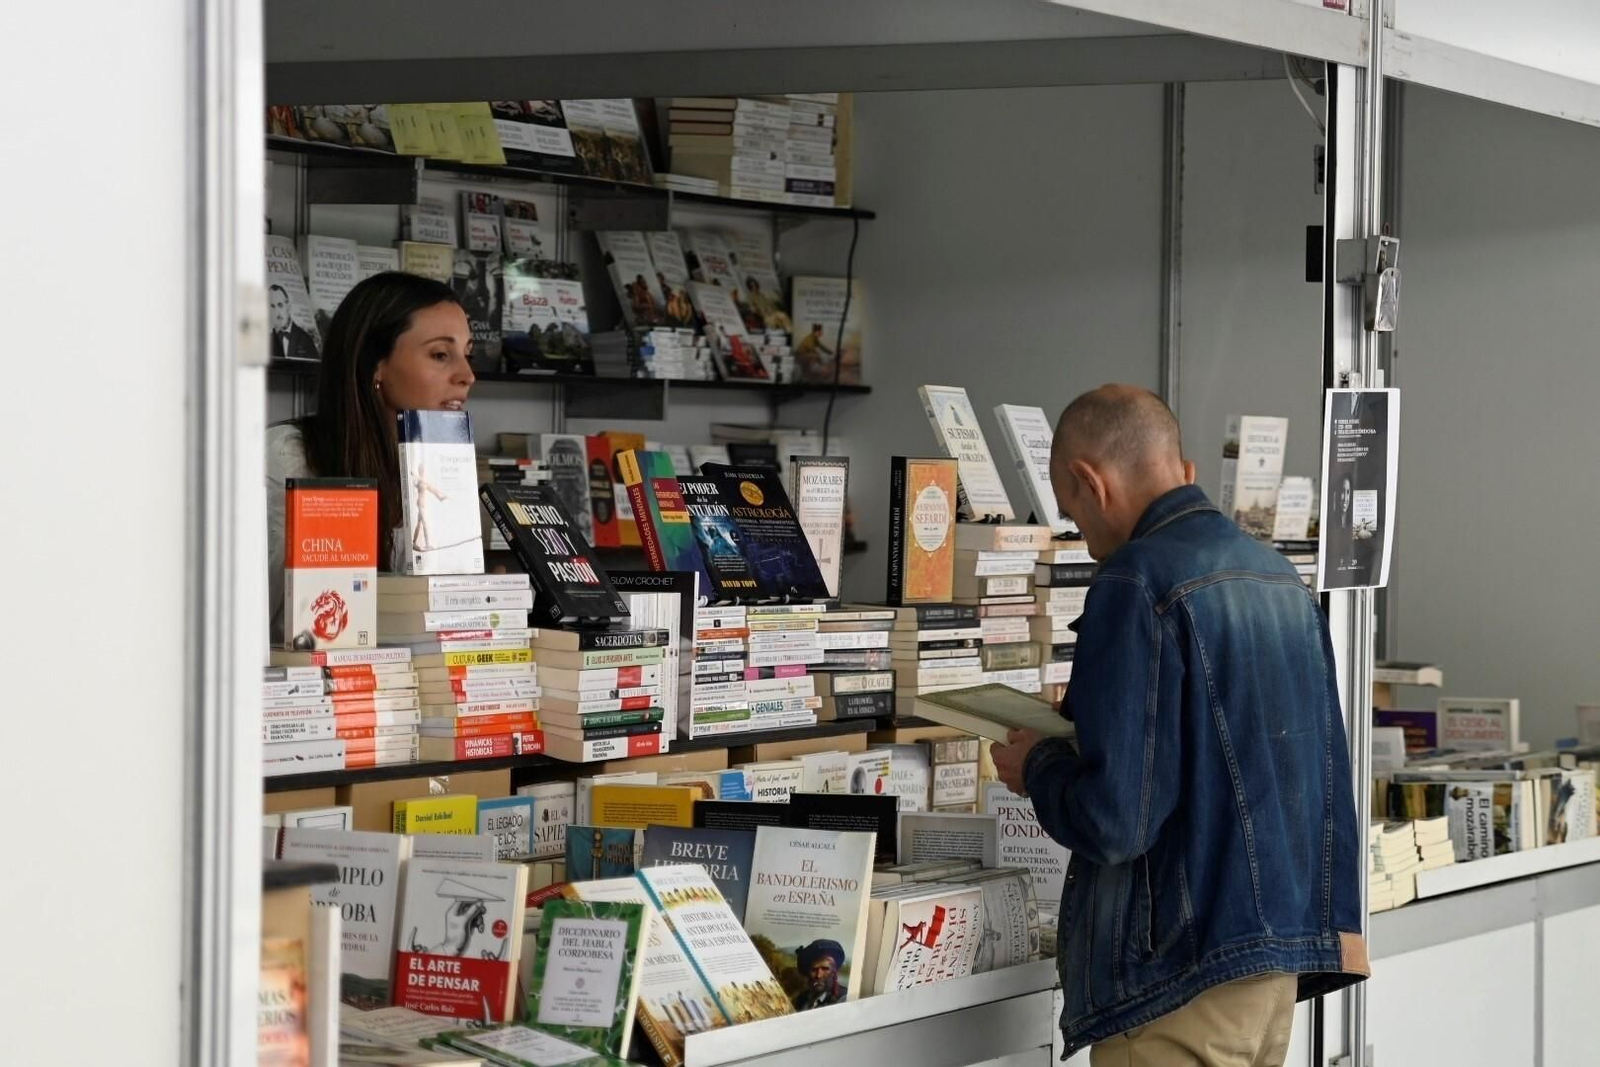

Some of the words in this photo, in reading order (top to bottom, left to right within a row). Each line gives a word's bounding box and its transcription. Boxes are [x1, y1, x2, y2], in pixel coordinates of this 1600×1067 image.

[522, 294, 548, 306] Baza
[802, 472, 844, 486] MOZÁRABES
[688, 482, 720, 496] PODER
[632, 487, 646, 522] MENTALES
[732, 506, 792, 518] ASTROLOGÍA
[302, 538, 342, 552] CHINA
[532, 528, 570, 556] SEXO
[561, 532, 578, 556] Y
[302, 554, 328, 562] SACUDE
[330, 554, 339, 562] AL
[340, 554, 368, 562] MUNDO
[547, 558, 600, 583] PASIÓN
[610, 576, 638, 586] SLOW
[638, 576, 675, 586] CROCHET
[720, 580, 740, 588] DAVID
[595, 634, 642, 647] SACERDOTAS
[452, 656, 476, 664] CULTURA
[476, 654, 494, 662] GEEK
[756, 702, 784, 712] GENIALES
[464, 738, 492, 748] DINÁMICAS
[758, 786, 788, 797] HISTORIA
[1478, 798, 1490, 808] El
[998, 806, 1036, 822] PENS
[488, 819, 495, 831] EL
[496, 814, 524, 828] LEGADO
[504, 832, 517, 844] LOS
[1480, 812, 1490, 859] camino
[670, 842, 729, 861] BREVE
[1003, 846, 1033, 854] CRÍTICA
[801, 860, 818, 873] EL
[756, 872, 858, 892] BANDOLERISMO
[328, 887, 341, 898] de
[772, 894, 786, 903] en
[788, 890, 836, 906] ESPAÑA
[680, 911, 714, 924] HISTORIA
[558, 927, 621, 938] DICCIONARIO
[686, 922, 739, 936] ANTROPOLOGÍA
[944, 908, 957, 952] DÍAS
[562, 938, 579, 948] DEL
[582, 939, 613, 950] HABLA
[716, 935, 748, 946] ESPAÑOLA
[946, 908, 966, 980] SETENT
[558, 948, 614, 960] CORDOBESA
[410, 958, 424, 970] EL
[427, 960, 461, 974] ARTE
[896, 951, 914, 992] PIENS
[408, 974, 426, 986] DE
[428, 975, 480, 992] PENSAR
[404, 1002, 418, 1010] José
[420, 1003, 440, 1012] Carlos
[441, 1005, 456, 1014] Ruiz
